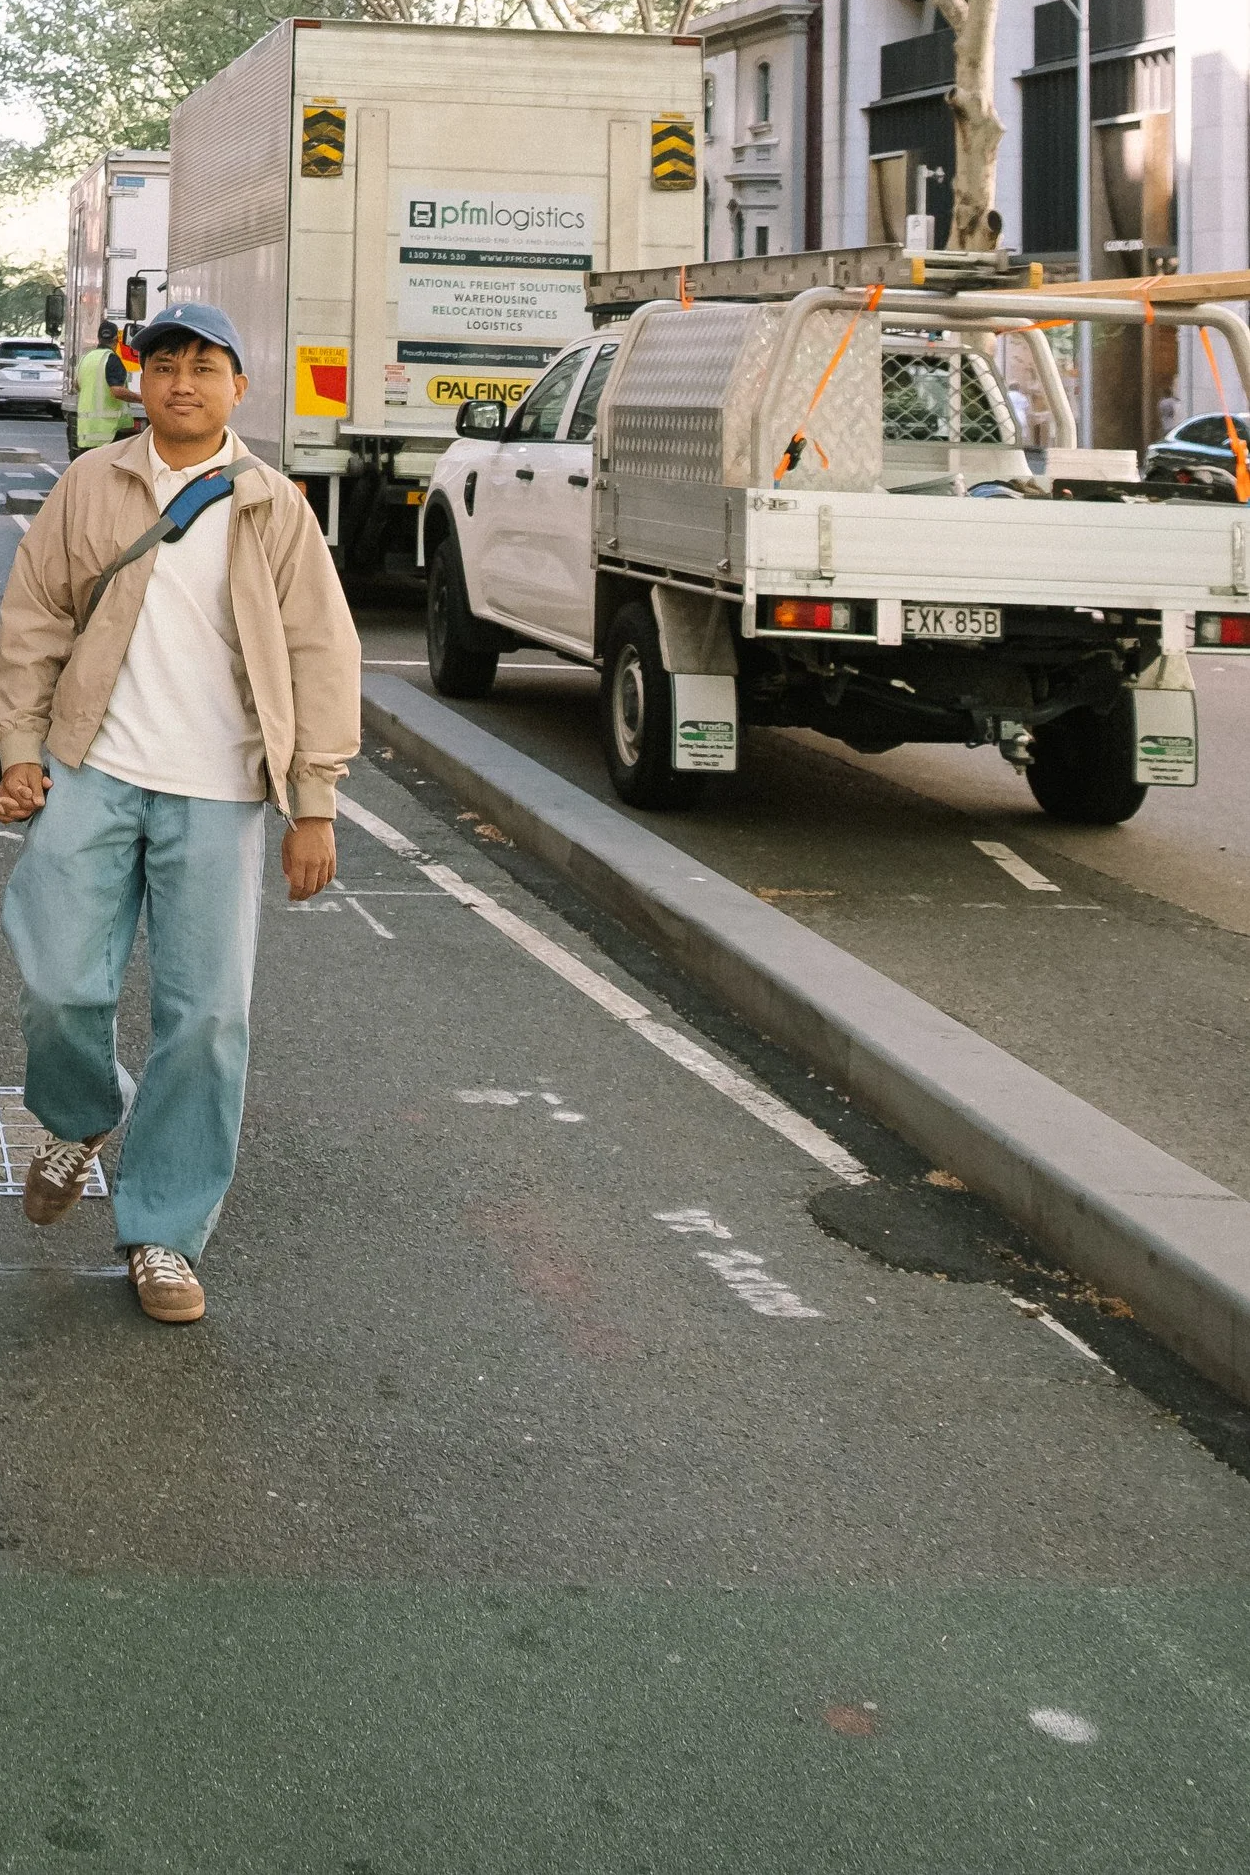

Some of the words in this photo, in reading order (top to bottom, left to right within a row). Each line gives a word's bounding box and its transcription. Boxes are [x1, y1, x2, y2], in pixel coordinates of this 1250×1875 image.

[441, 200, 585, 231] pfmlogistics
[409, 251, 430, 259] 1300
[432, 252, 447, 260] 736
[450, 253, 466, 261] 530
[479, 254, 585, 266] WWW.PFMCORP.COM.AU
[409, 278, 466, 289] NATIONAL
[470, 280, 516, 292] FREIGHT
[519, 282, 582, 294] SOLUTIONS
[454, 293, 538, 305] WAREHOUSING
[432, 305, 502, 317] RELOCATION
[506, 309, 558, 320] SERVICES
[466, 320, 523, 332] LOGISTICS
